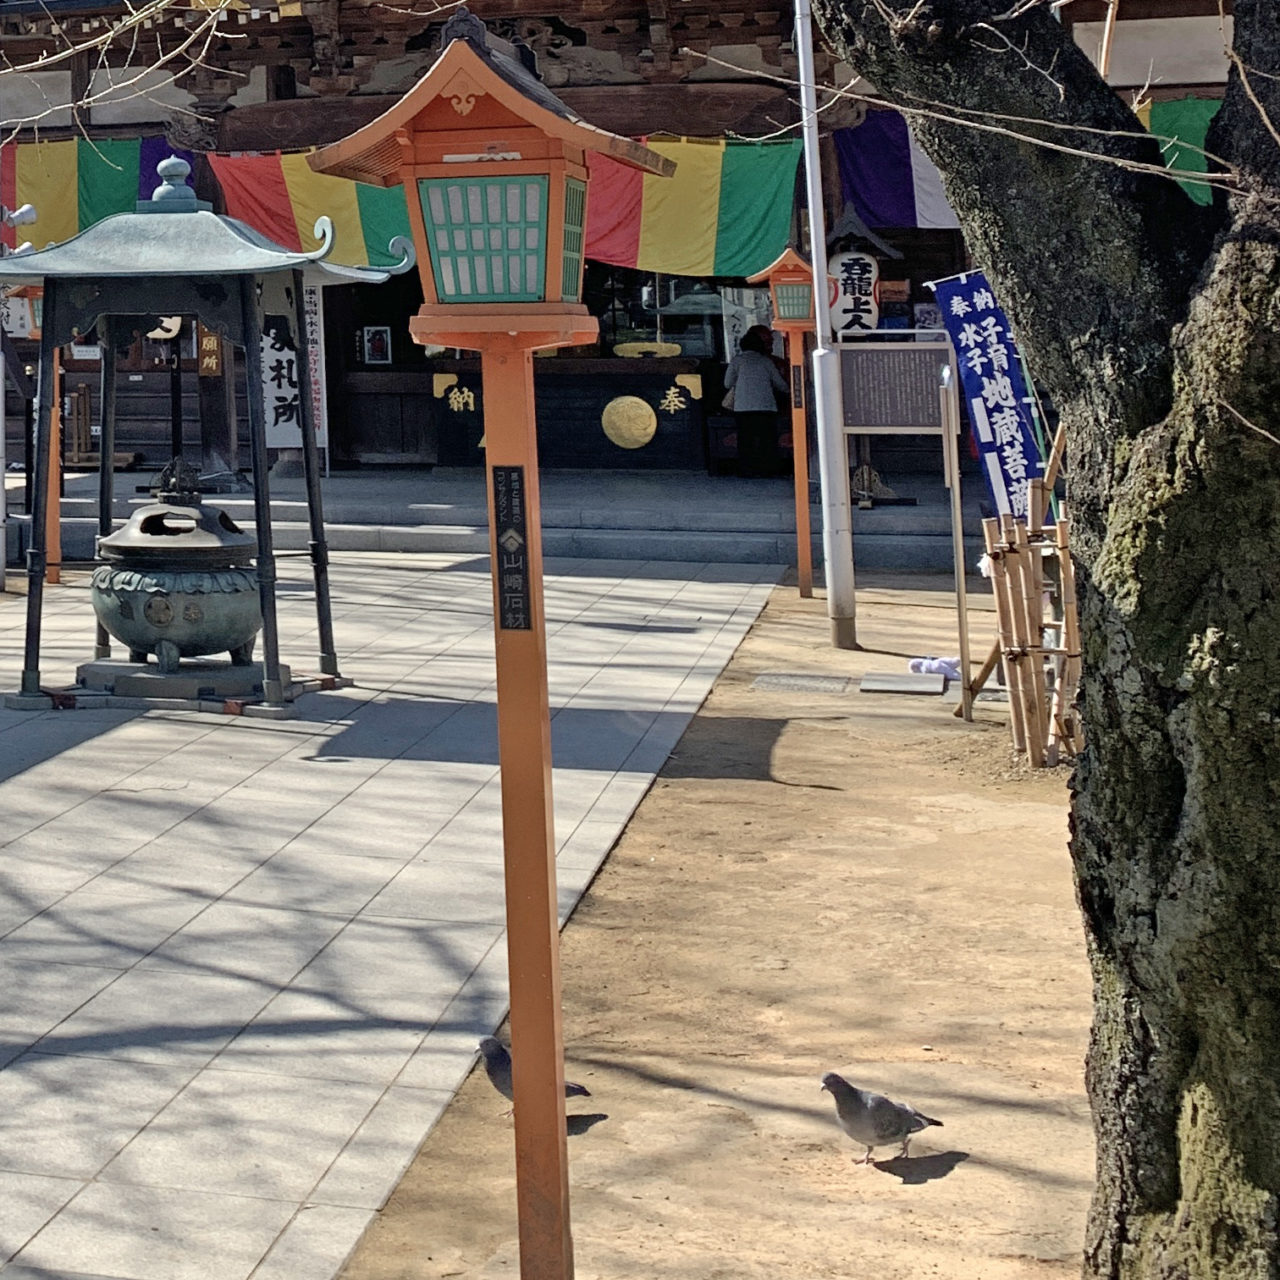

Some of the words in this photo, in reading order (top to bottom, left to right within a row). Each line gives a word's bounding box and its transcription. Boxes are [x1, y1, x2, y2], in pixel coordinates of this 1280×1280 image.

[949, 288, 996, 318] 奉納
[958, 322, 989, 376] 水子
[448, 386, 475, 412] 納
[659, 386, 687, 414] 奉
